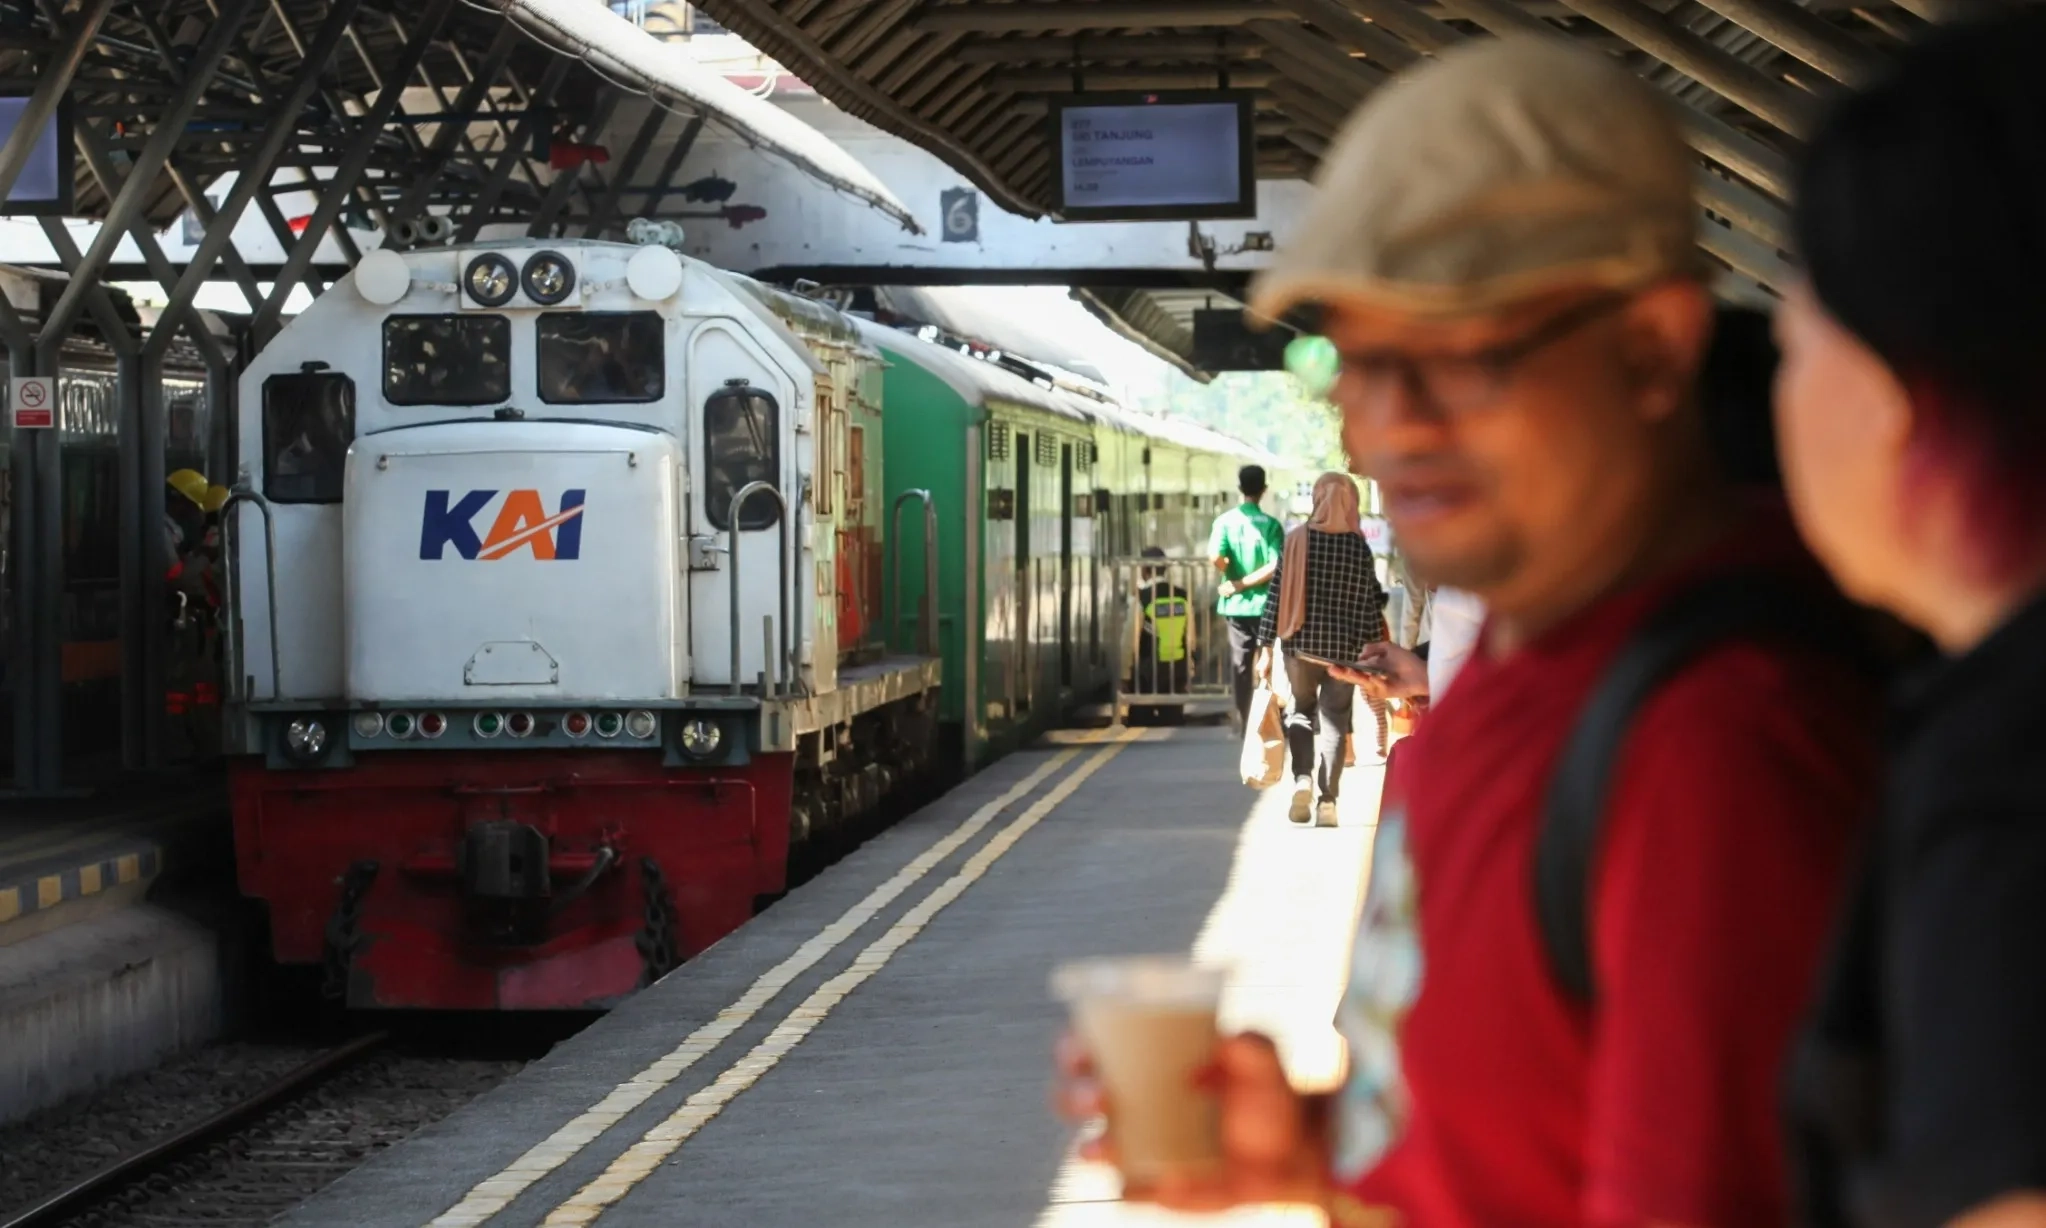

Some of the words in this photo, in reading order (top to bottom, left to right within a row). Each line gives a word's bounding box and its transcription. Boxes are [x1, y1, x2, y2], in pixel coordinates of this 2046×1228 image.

[1094, 129, 1153, 140] TANJUNG
[947, 196, 973, 234] 6
[419, 489, 586, 560] KAI
